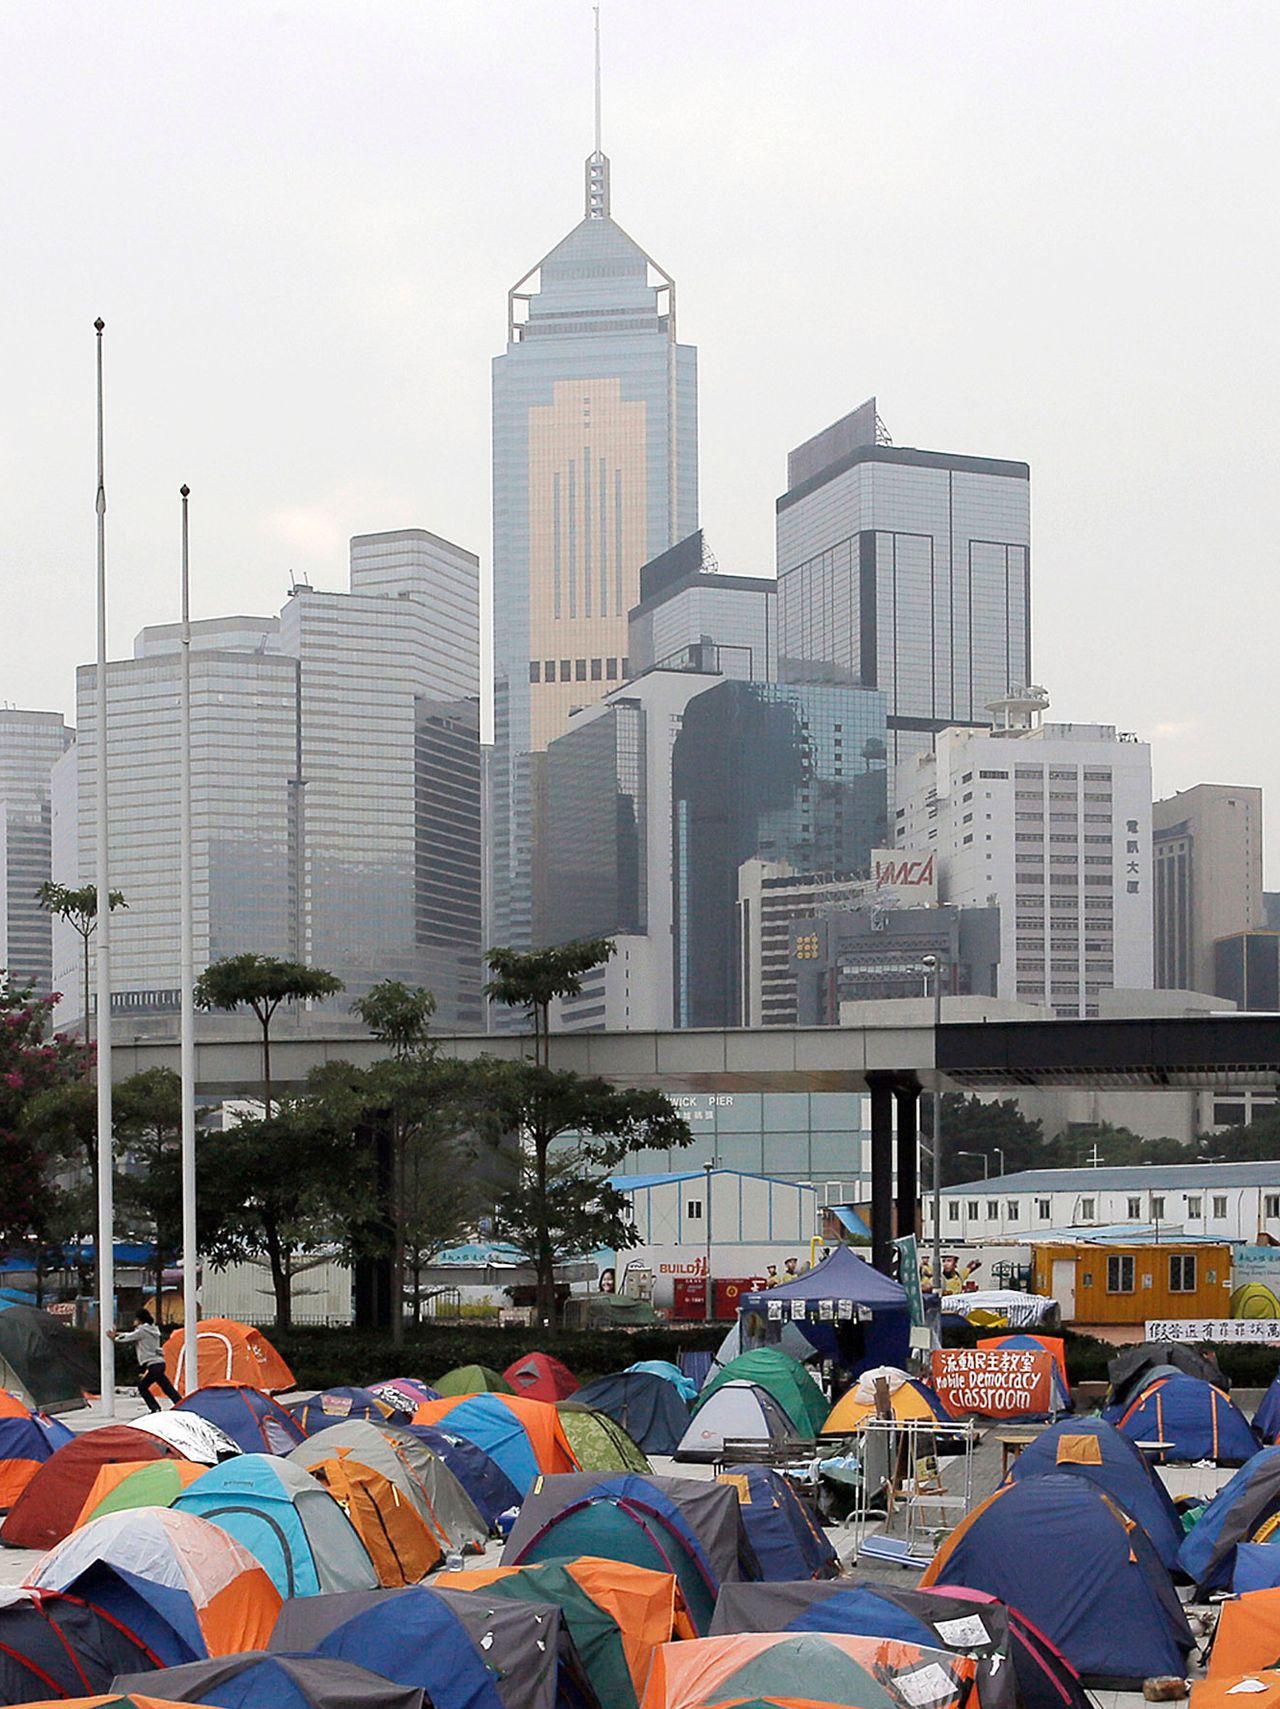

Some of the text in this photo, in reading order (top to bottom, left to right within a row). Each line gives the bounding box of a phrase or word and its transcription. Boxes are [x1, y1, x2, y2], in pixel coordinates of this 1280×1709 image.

[875, 855, 933, 889] YMCA
[708, 1096, 734, 1107] PIER
[941, 1352, 1035, 1373] 流動民主教室
